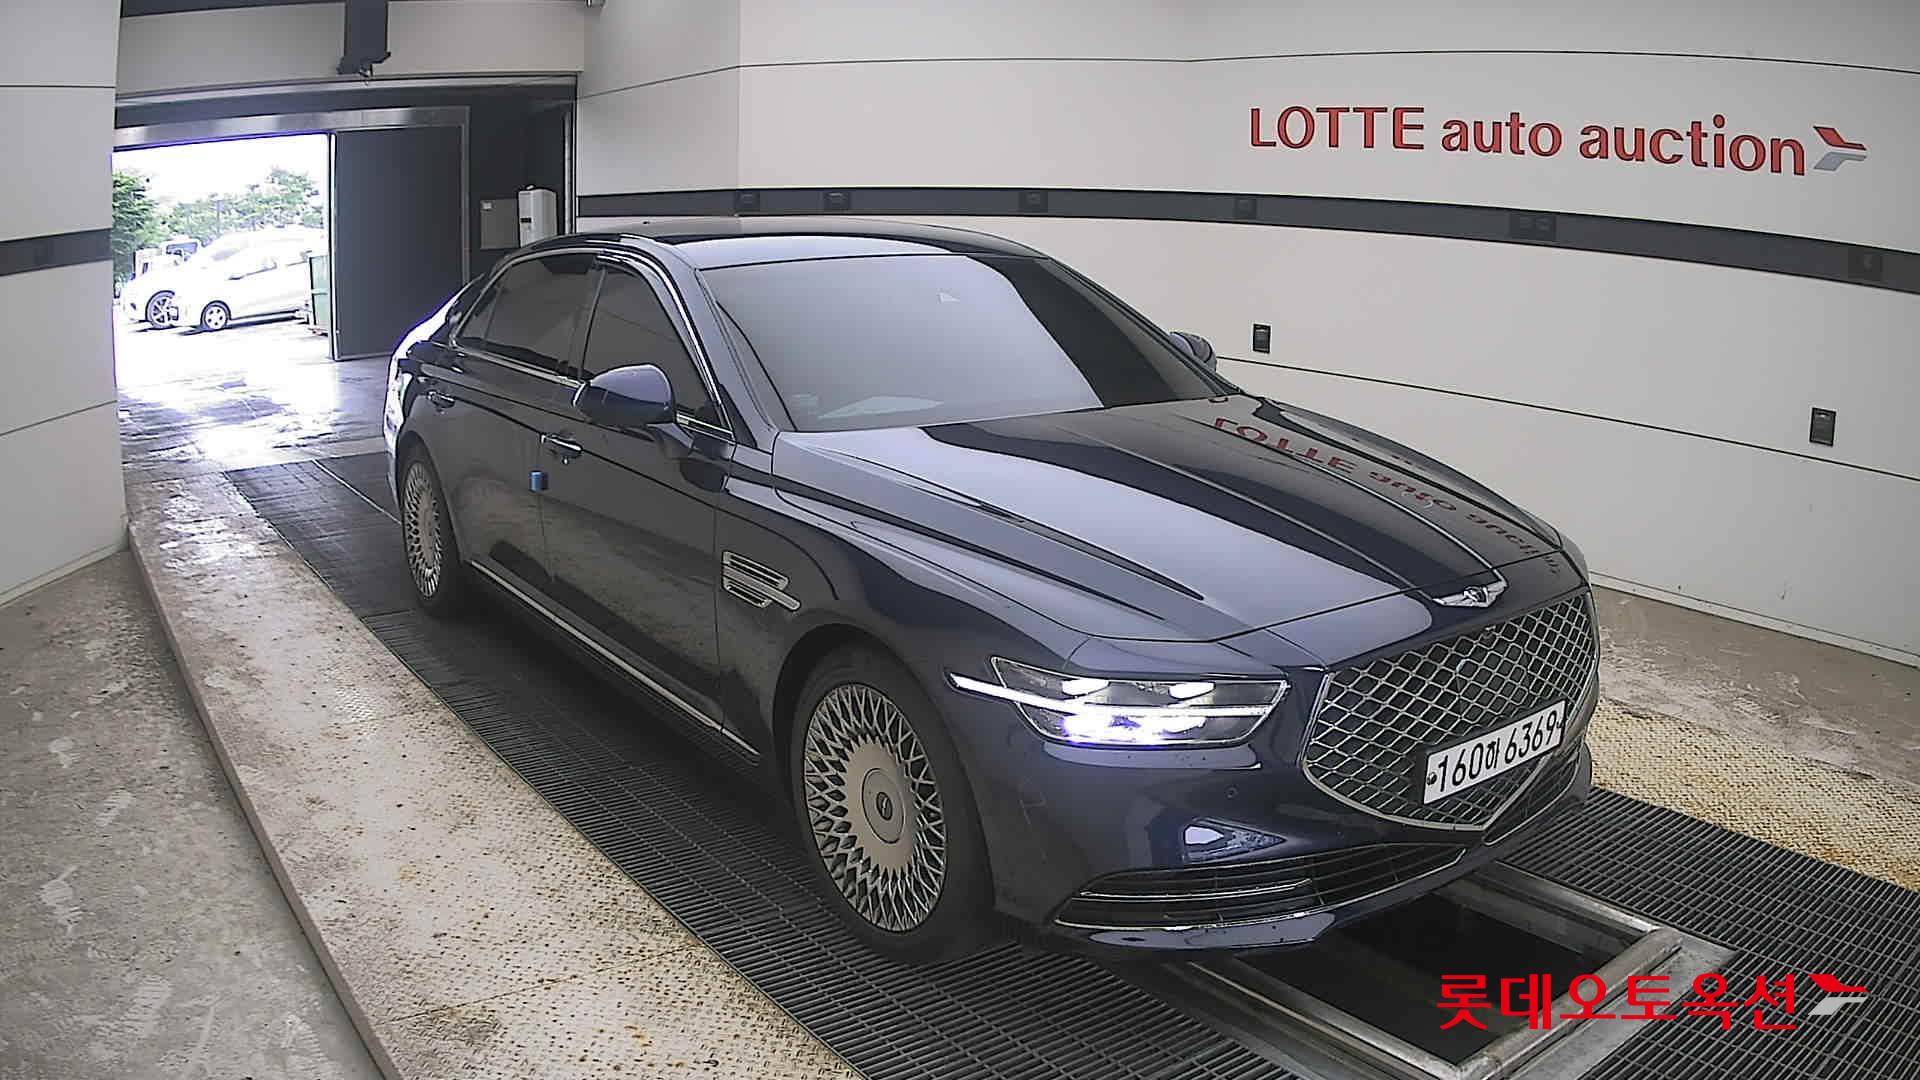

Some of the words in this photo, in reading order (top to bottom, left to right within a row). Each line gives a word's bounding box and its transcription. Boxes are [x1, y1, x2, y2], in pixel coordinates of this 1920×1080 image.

[1250, 106, 1426, 151] LOTTE
[1442, 112, 1562, 155] auto
[1579, 114, 1806, 177] auction
[1438, 737, 1501, 793] 160하
[1505, 710, 1558, 763] 6369
